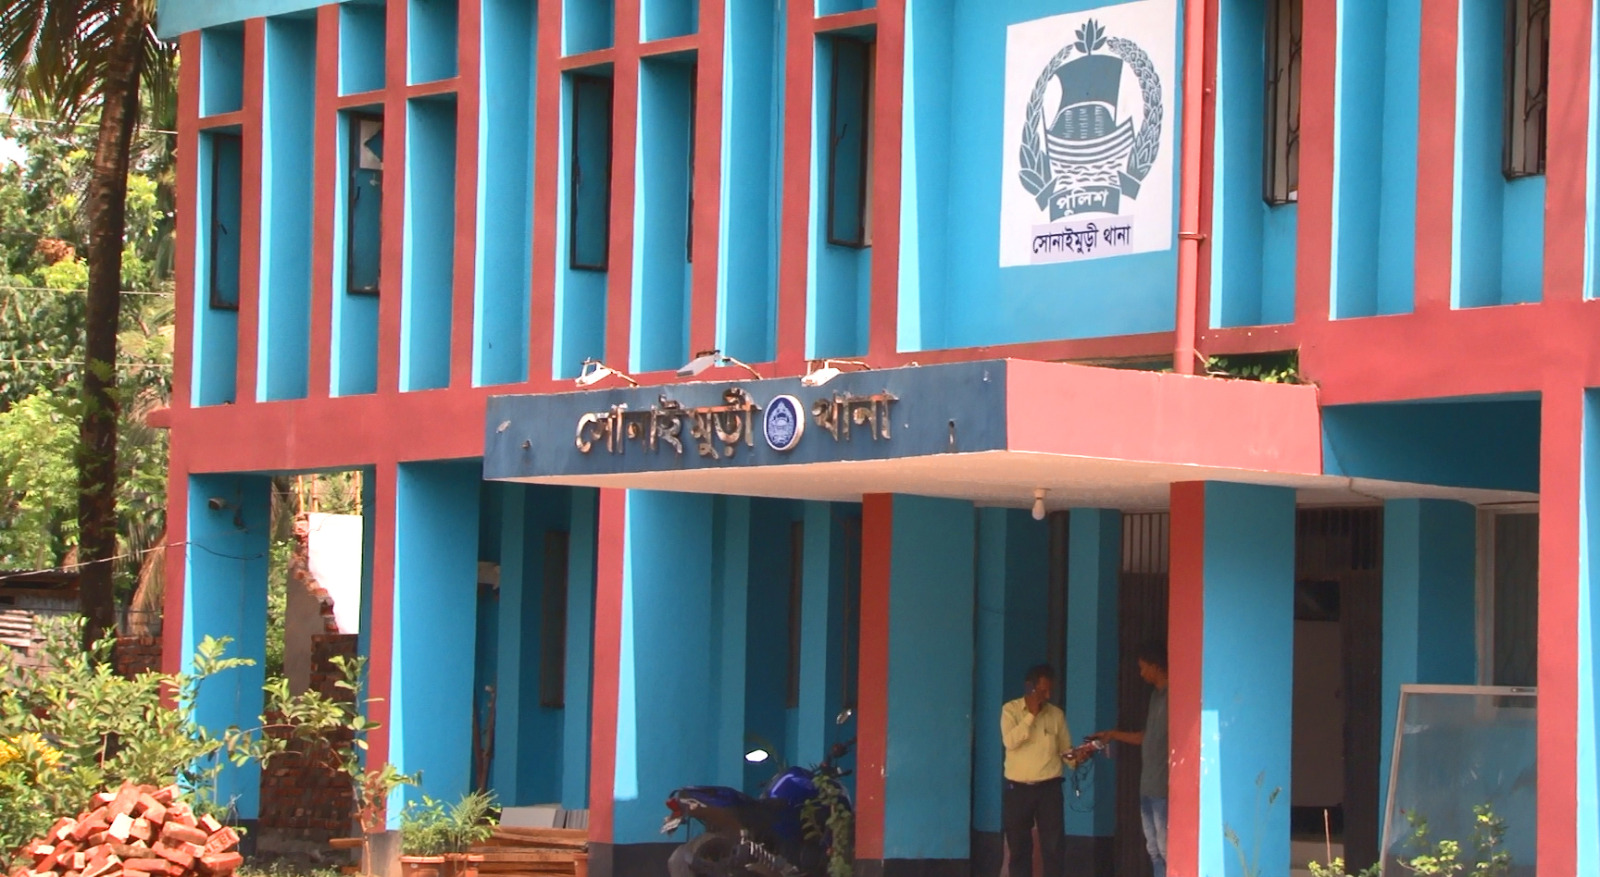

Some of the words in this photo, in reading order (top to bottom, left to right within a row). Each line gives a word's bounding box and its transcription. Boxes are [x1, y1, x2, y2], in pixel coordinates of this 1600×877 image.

[1056, 188, 1109, 216] পুলিশ
[1033, 222, 1099, 254] সোনাইমুড়ী
[1103, 224, 1131, 246] থানা
[575, 387, 762, 459] সোনাইমুড়ী
[811, 389, 899, 441] থানা
